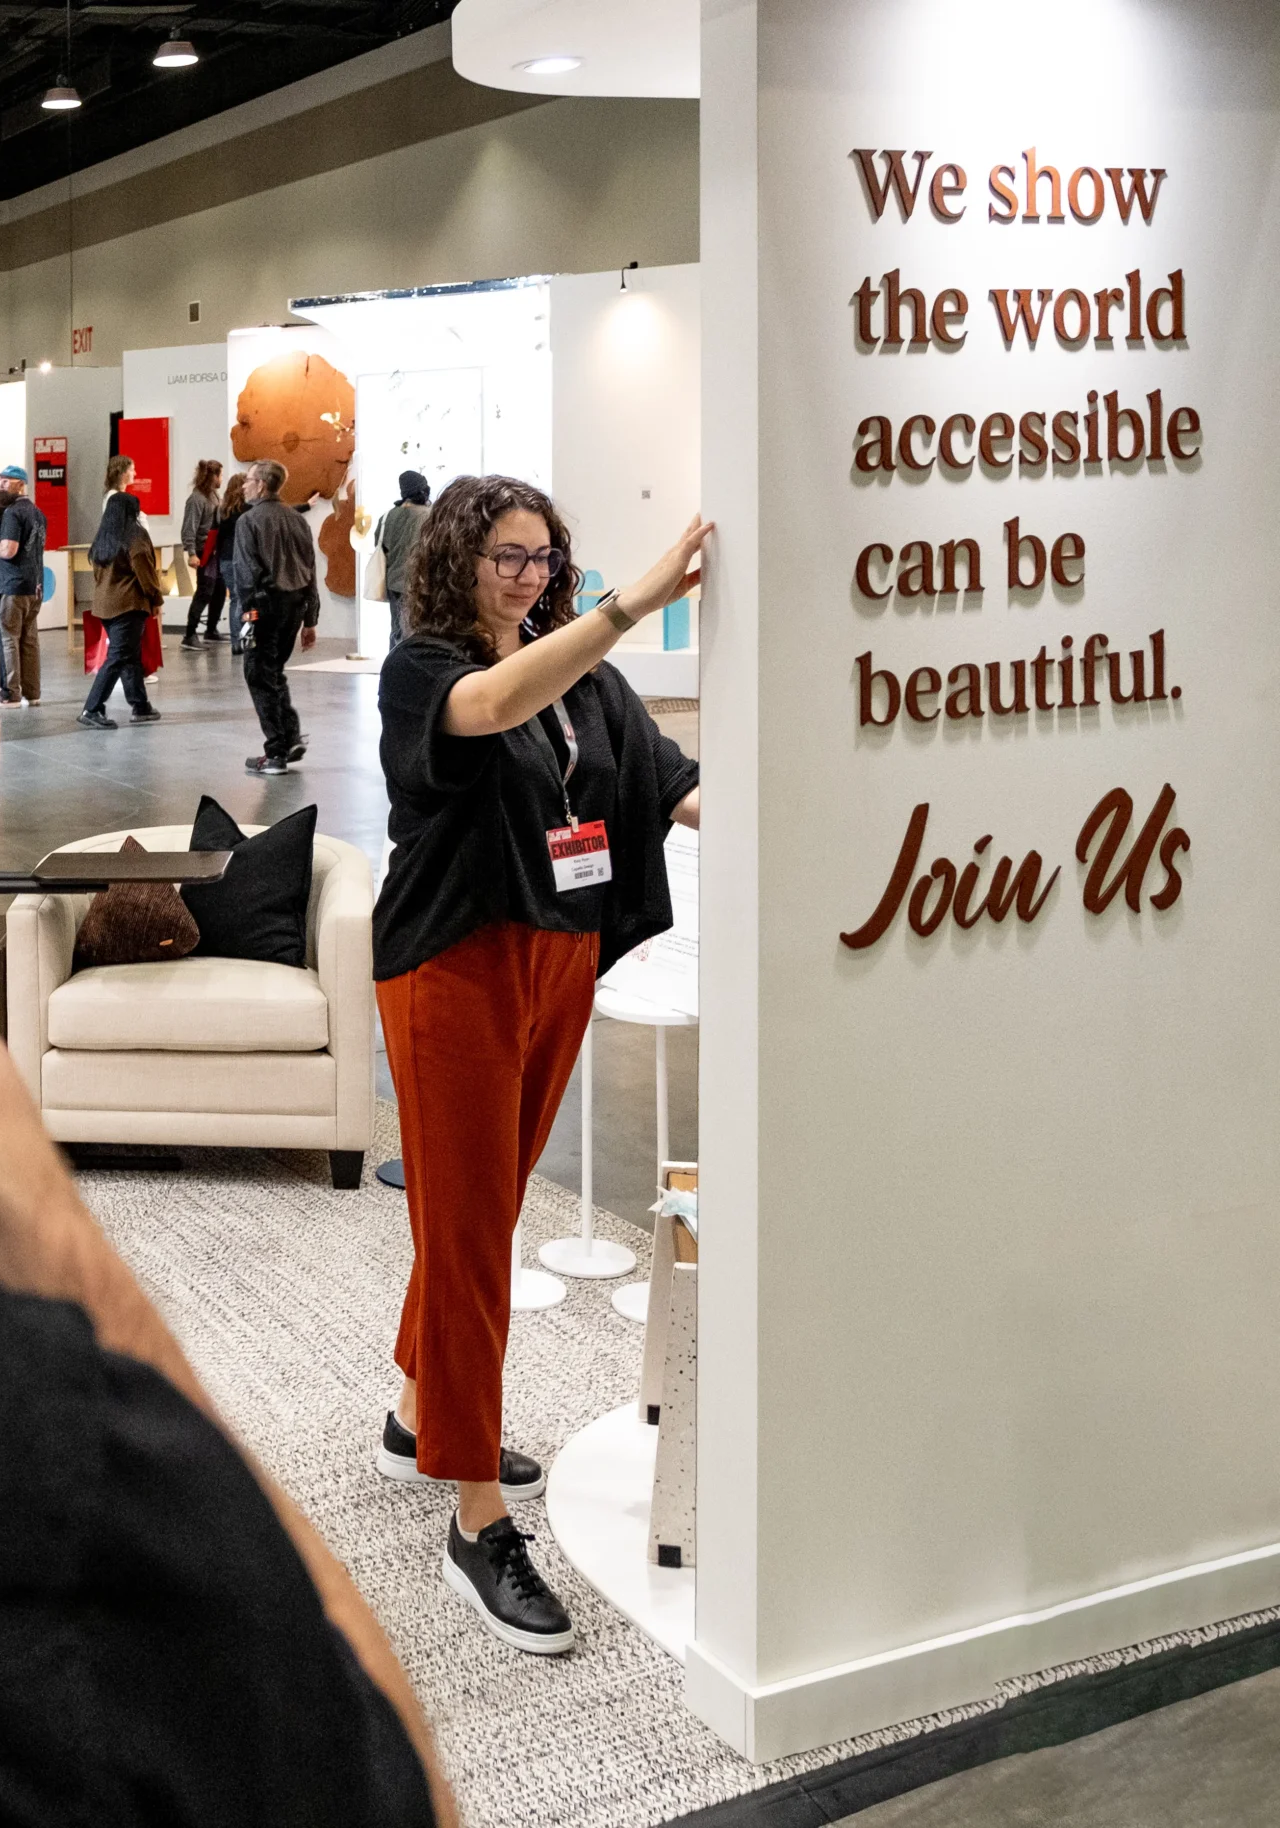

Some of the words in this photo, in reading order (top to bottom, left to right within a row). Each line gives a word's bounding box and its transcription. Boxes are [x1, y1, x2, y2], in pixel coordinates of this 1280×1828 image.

[851, 147, 968, 223] We
[989, 147, 1167, 223] show
[73, 326, 93, 353] EXIT
[853, 269, 969, 346] the
[989, 268, 1188, 345] world
[189, 372, 219, 384] BORSA
[855, 389, 1202, 474] accessible
[38, 468, 64, 479] COLLECT
[855, 537, 985, 600] can
[1004, 516, 1087, 589] be
[855, 628, 1184, 727] beautiful.
[551, 835, 606, 859] EXHIBITOR
[839, 801, 1062, 950] Join
[1074, 781, 1191, 916] Us
